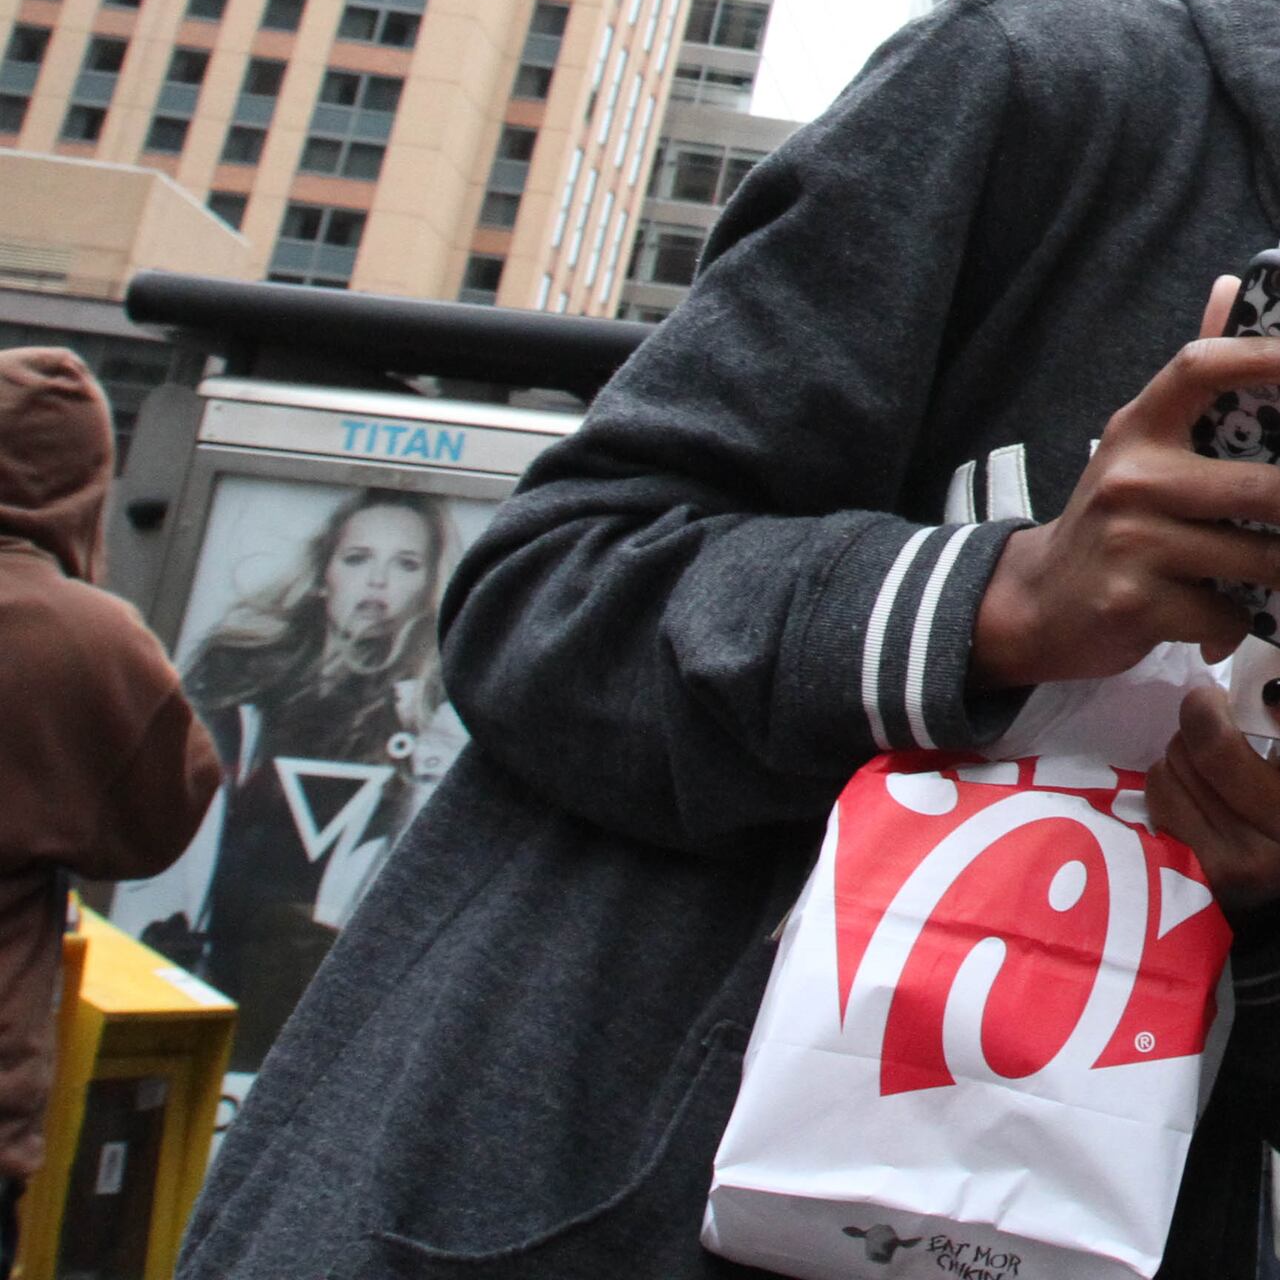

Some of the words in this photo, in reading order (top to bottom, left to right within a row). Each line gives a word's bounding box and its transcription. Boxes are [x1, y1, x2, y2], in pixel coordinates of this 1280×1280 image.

[341, 420, 466, 463] TITAN
[925, 1234, 971, 1257] EAT
[973, 1246, 1022, 1276] MOR
